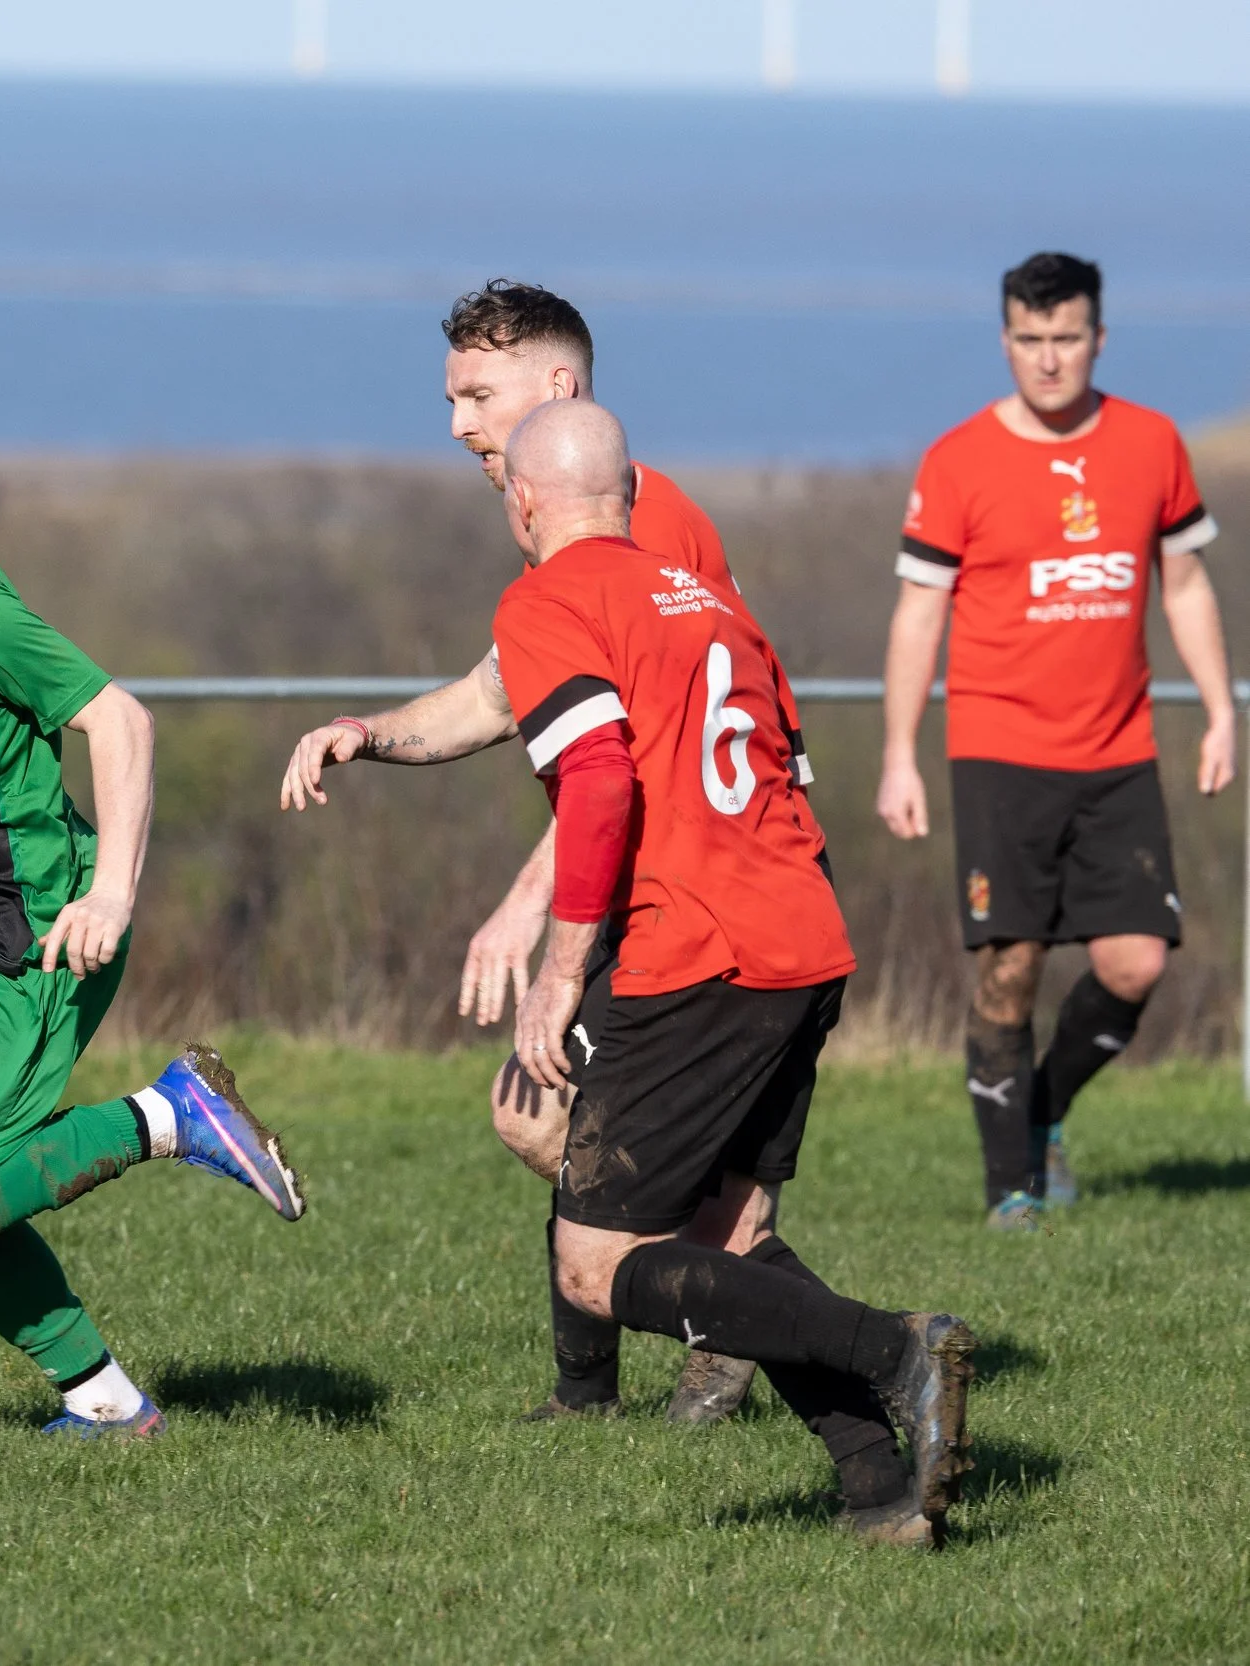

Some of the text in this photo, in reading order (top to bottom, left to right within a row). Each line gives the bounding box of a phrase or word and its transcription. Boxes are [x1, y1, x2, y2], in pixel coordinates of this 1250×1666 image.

[1030, 551, 1136, 598] PSS
[651, 593, 673, 605] RG
[659, 601, 702, 616] cleaning
[701, 642, 756, 815] 6
